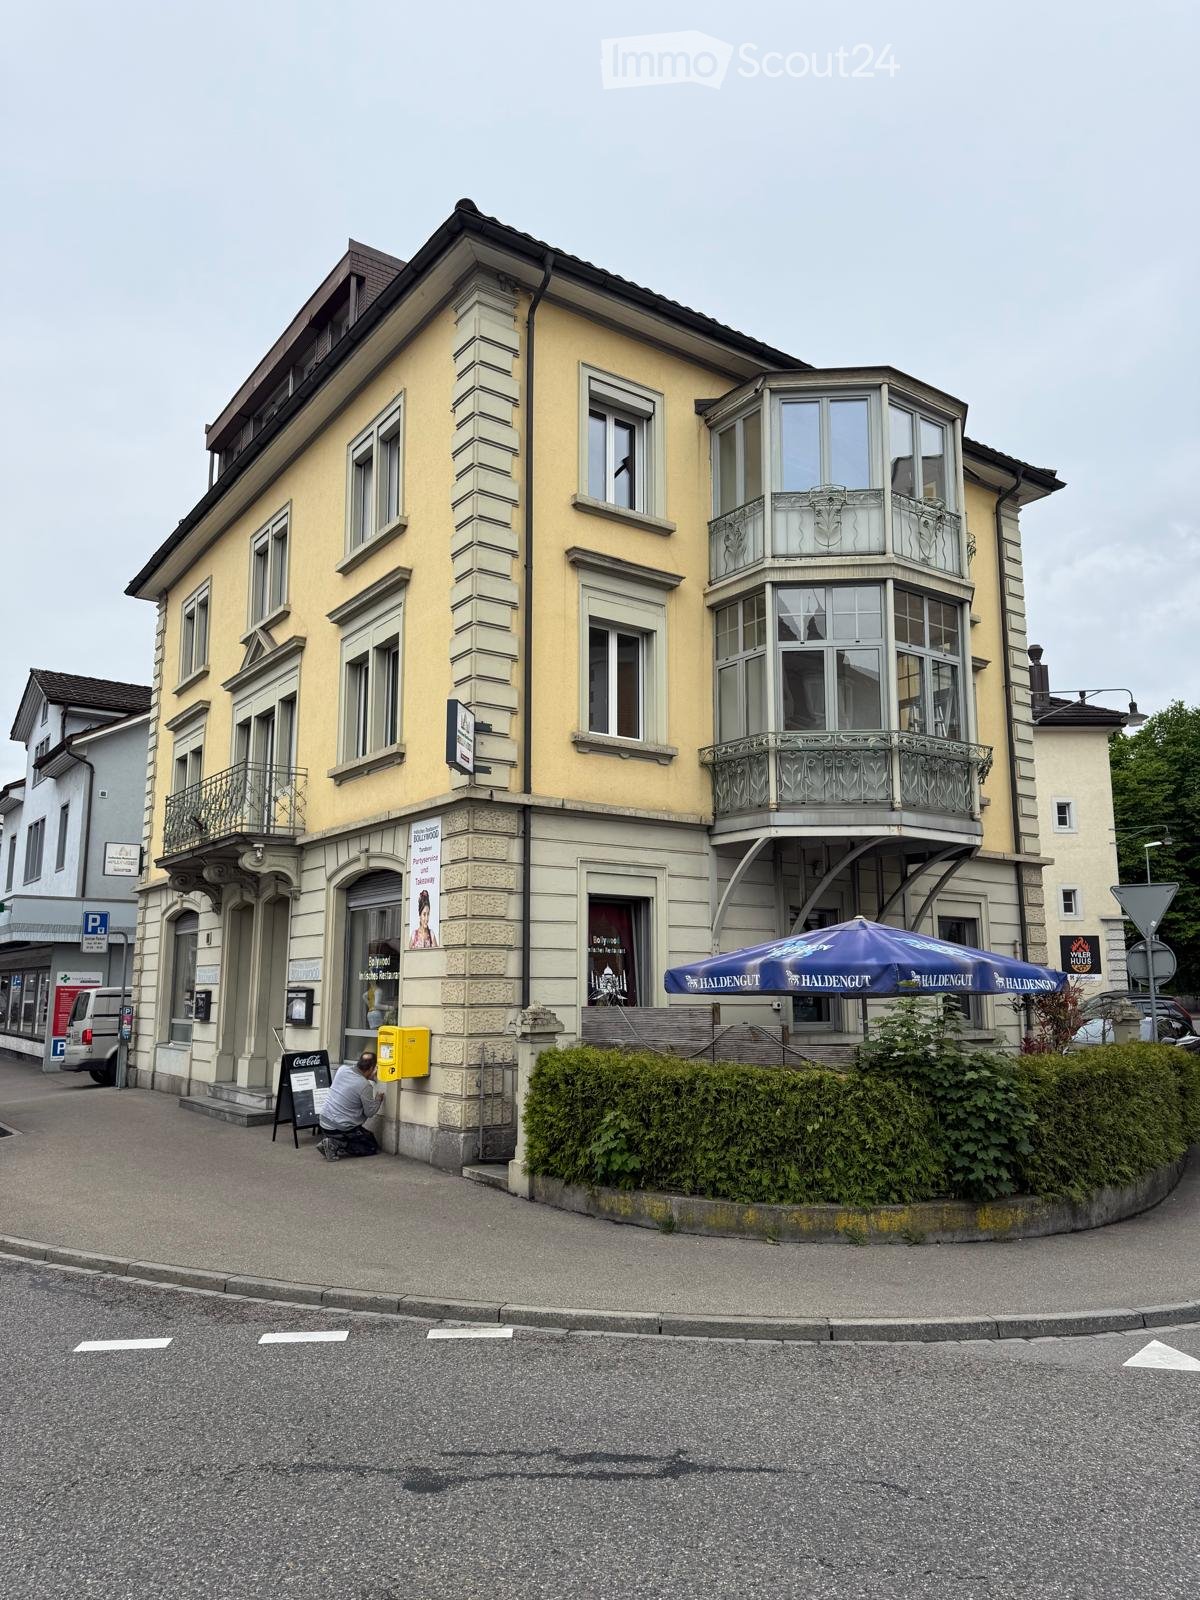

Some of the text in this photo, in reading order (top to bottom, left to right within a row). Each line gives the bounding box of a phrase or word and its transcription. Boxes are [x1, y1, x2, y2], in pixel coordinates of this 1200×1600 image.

[414, 830, 439, 843] BOLLYWOOD
[88, 914, 101, 933] P
[593, 936, 621, 946] Bollywood
[368, 955, 391, 969] Bollywood
[1070, 957, 1092, 965] HUUS
[700, 974, 761, 990] HALDENGUT
[801, 974, 872, 988] HALDENGUT
[921, 974, 973, 988] HALDENGUT
